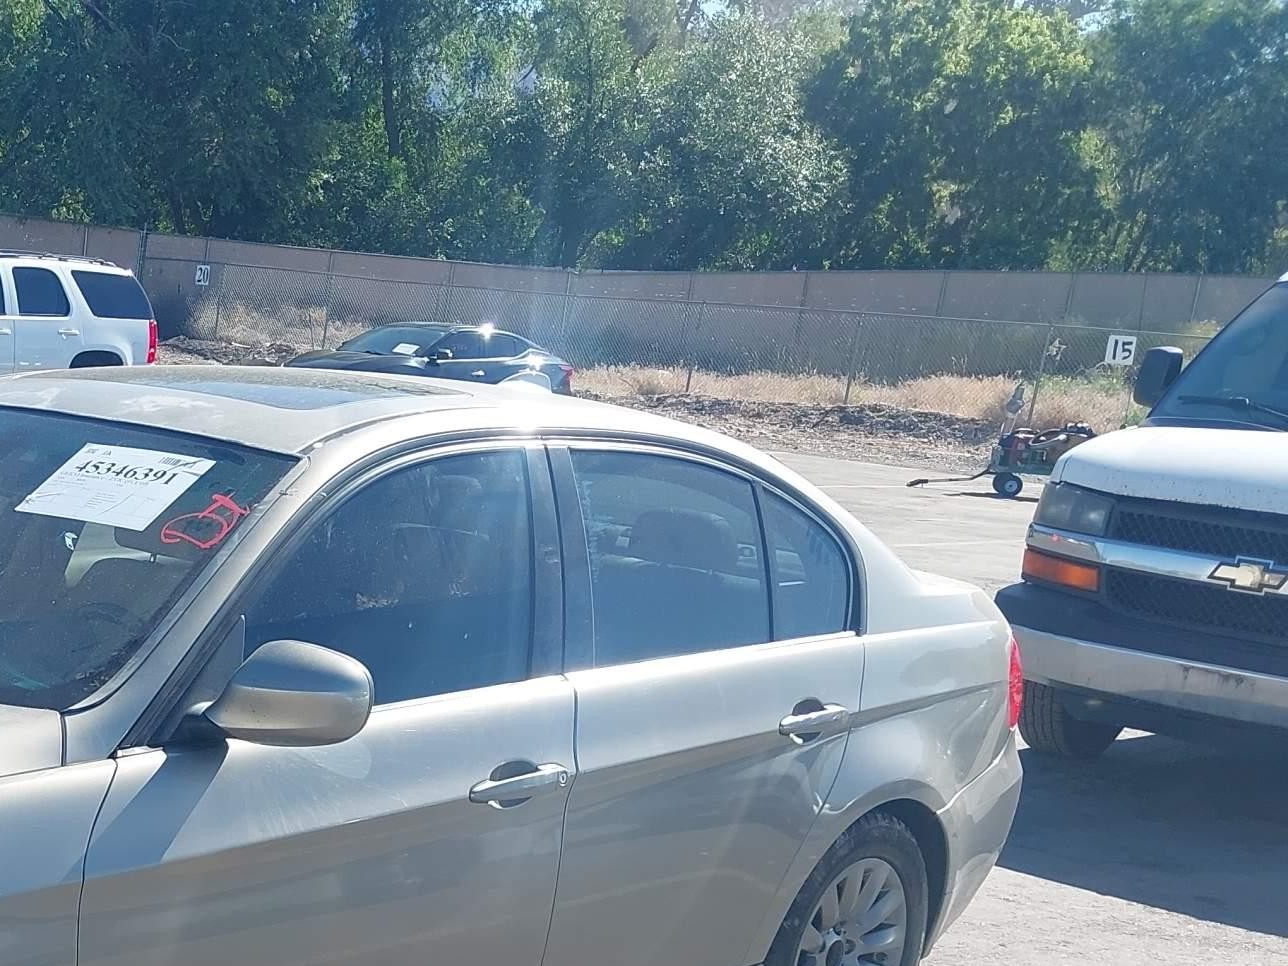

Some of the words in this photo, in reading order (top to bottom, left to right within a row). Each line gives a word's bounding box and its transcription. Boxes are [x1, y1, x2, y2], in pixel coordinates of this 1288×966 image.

[196, 267, 209, 284] 20
[1112, 339, 1133, 360] 15
[75, 459, 179, 485] 45346391
